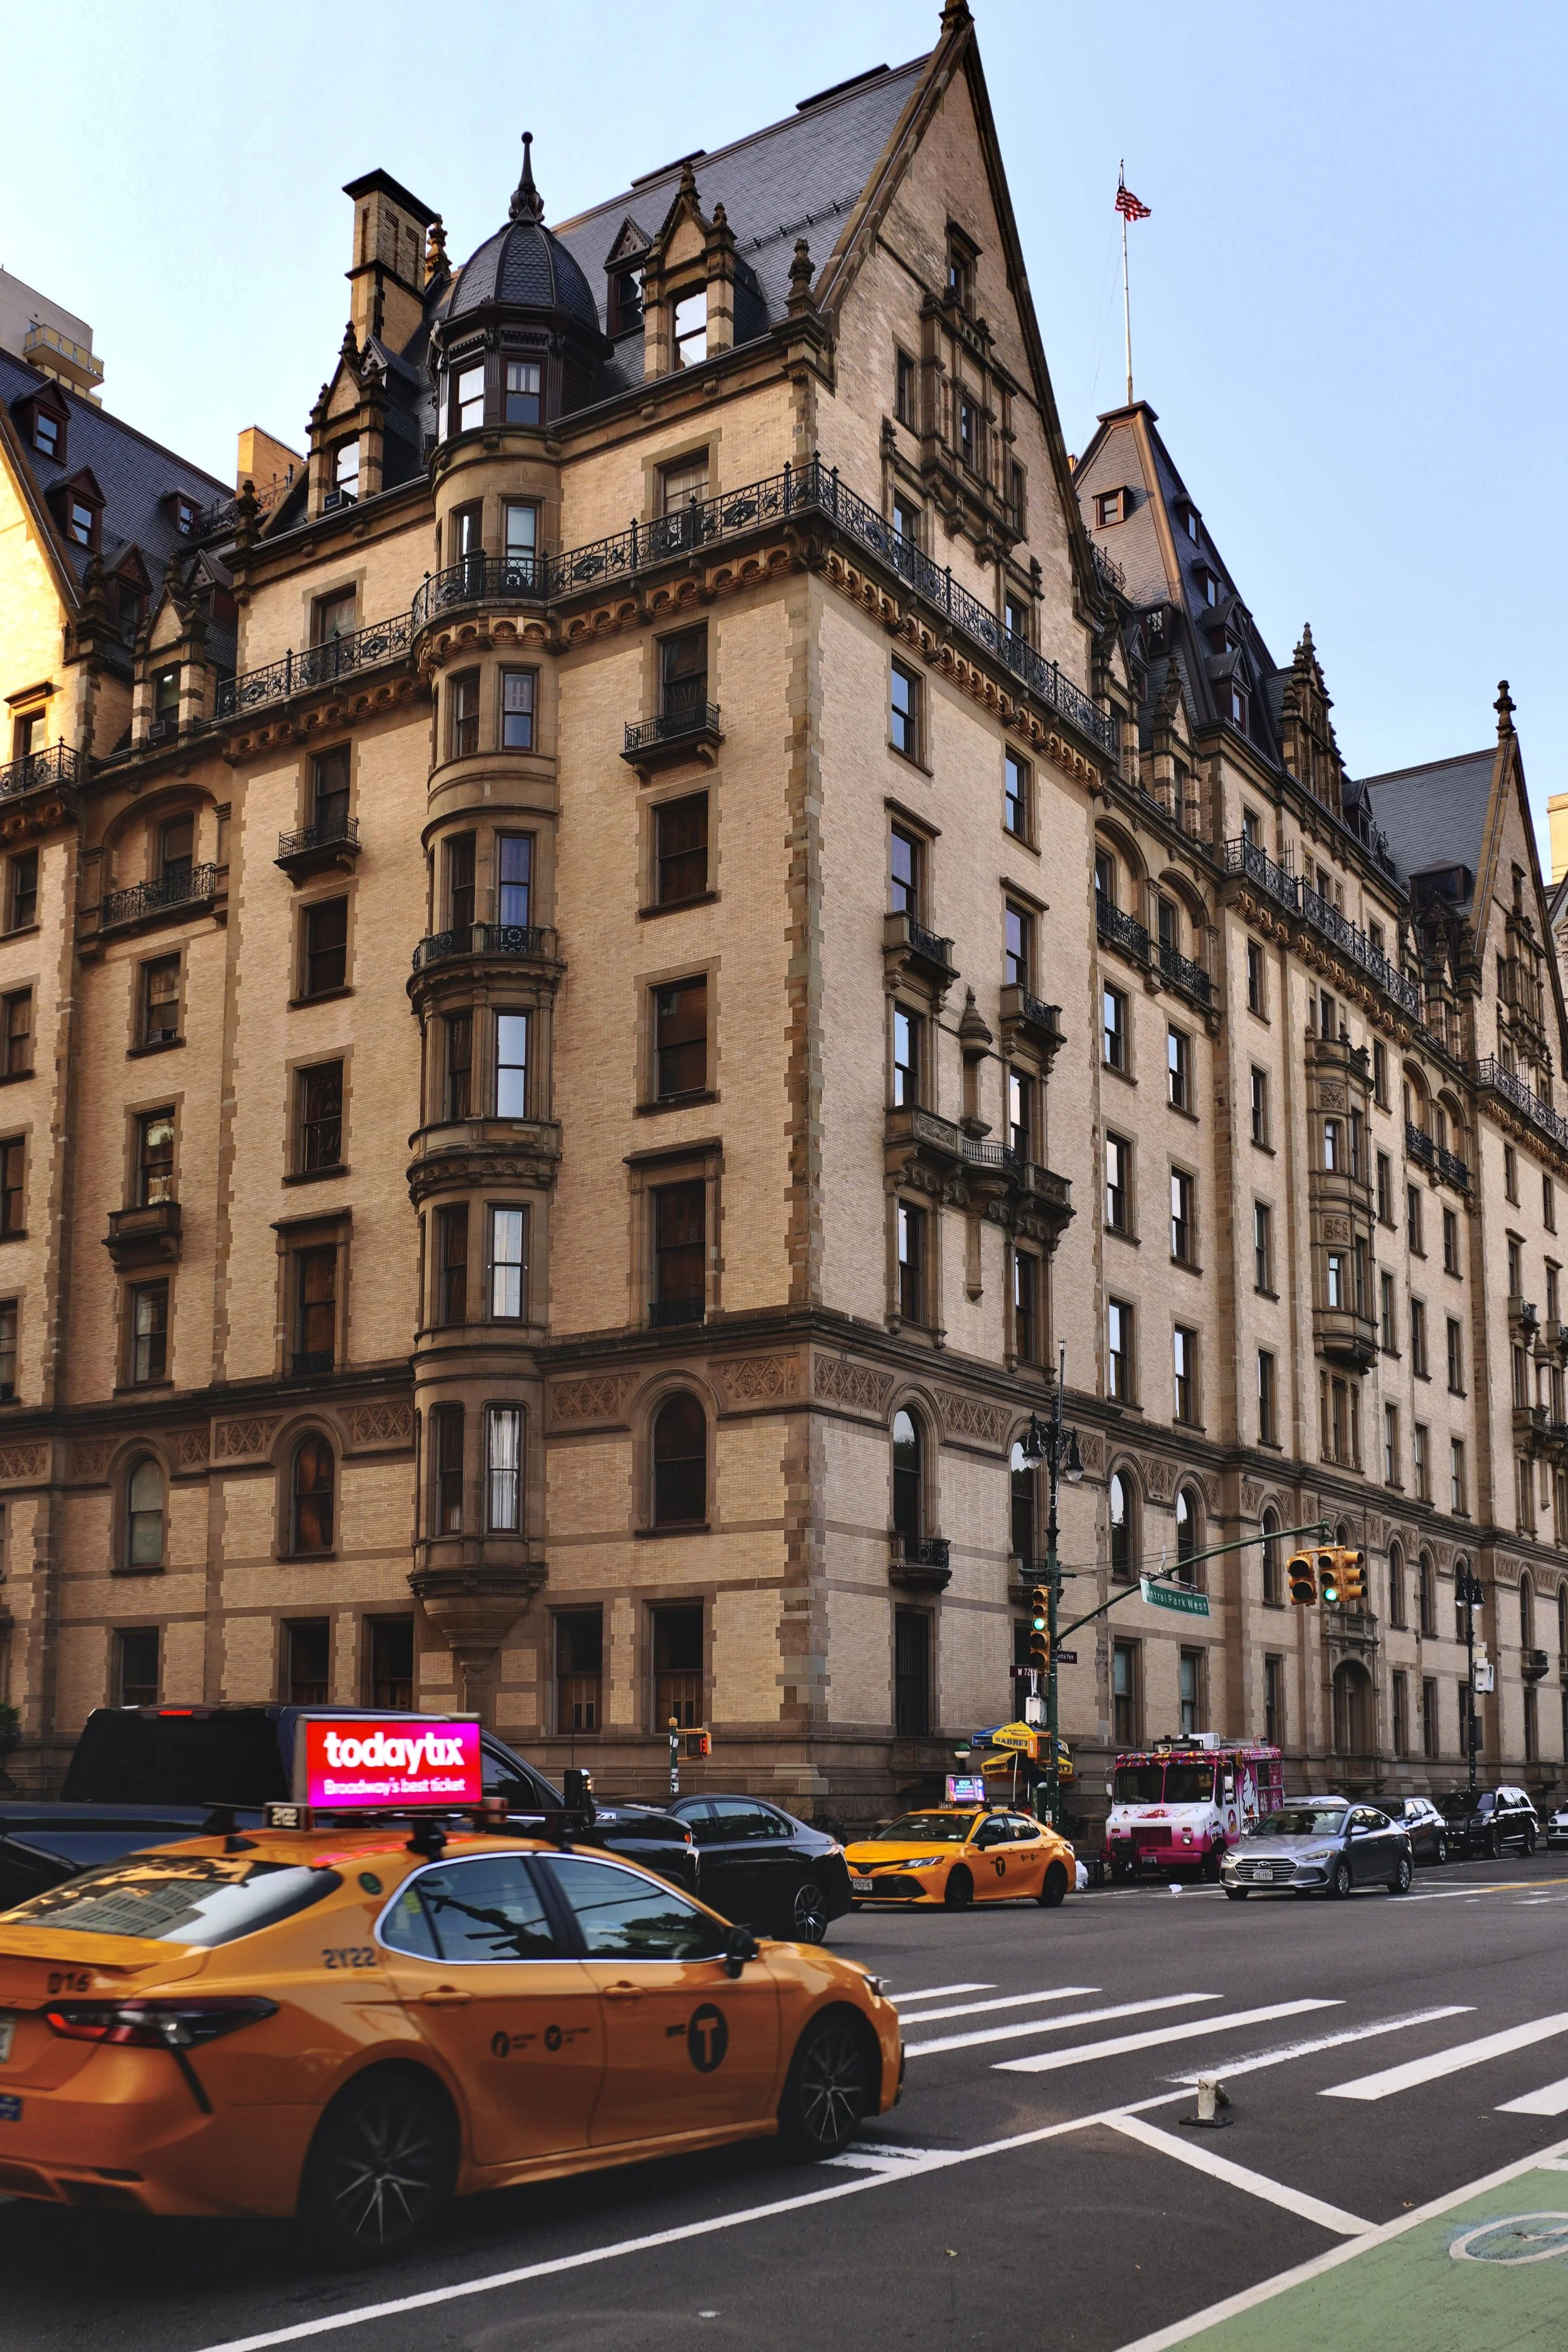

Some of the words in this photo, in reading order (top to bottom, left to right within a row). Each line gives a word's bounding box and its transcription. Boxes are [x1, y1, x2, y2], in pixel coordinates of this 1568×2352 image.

[1145, 1589, 1167, 1603] entral
[1168, 1594, 1186, 1607] Park
[1187, 1599, 1207, 1611] West
[995, 1737, 1028, 1747] SABRET
[323, 1732, 465, 1774] todaytix
[324, 1777, 400, 1796] Broadway's
[400, 1778, 430, 1793] best
[430, 1777, 465, 1792] ticket
